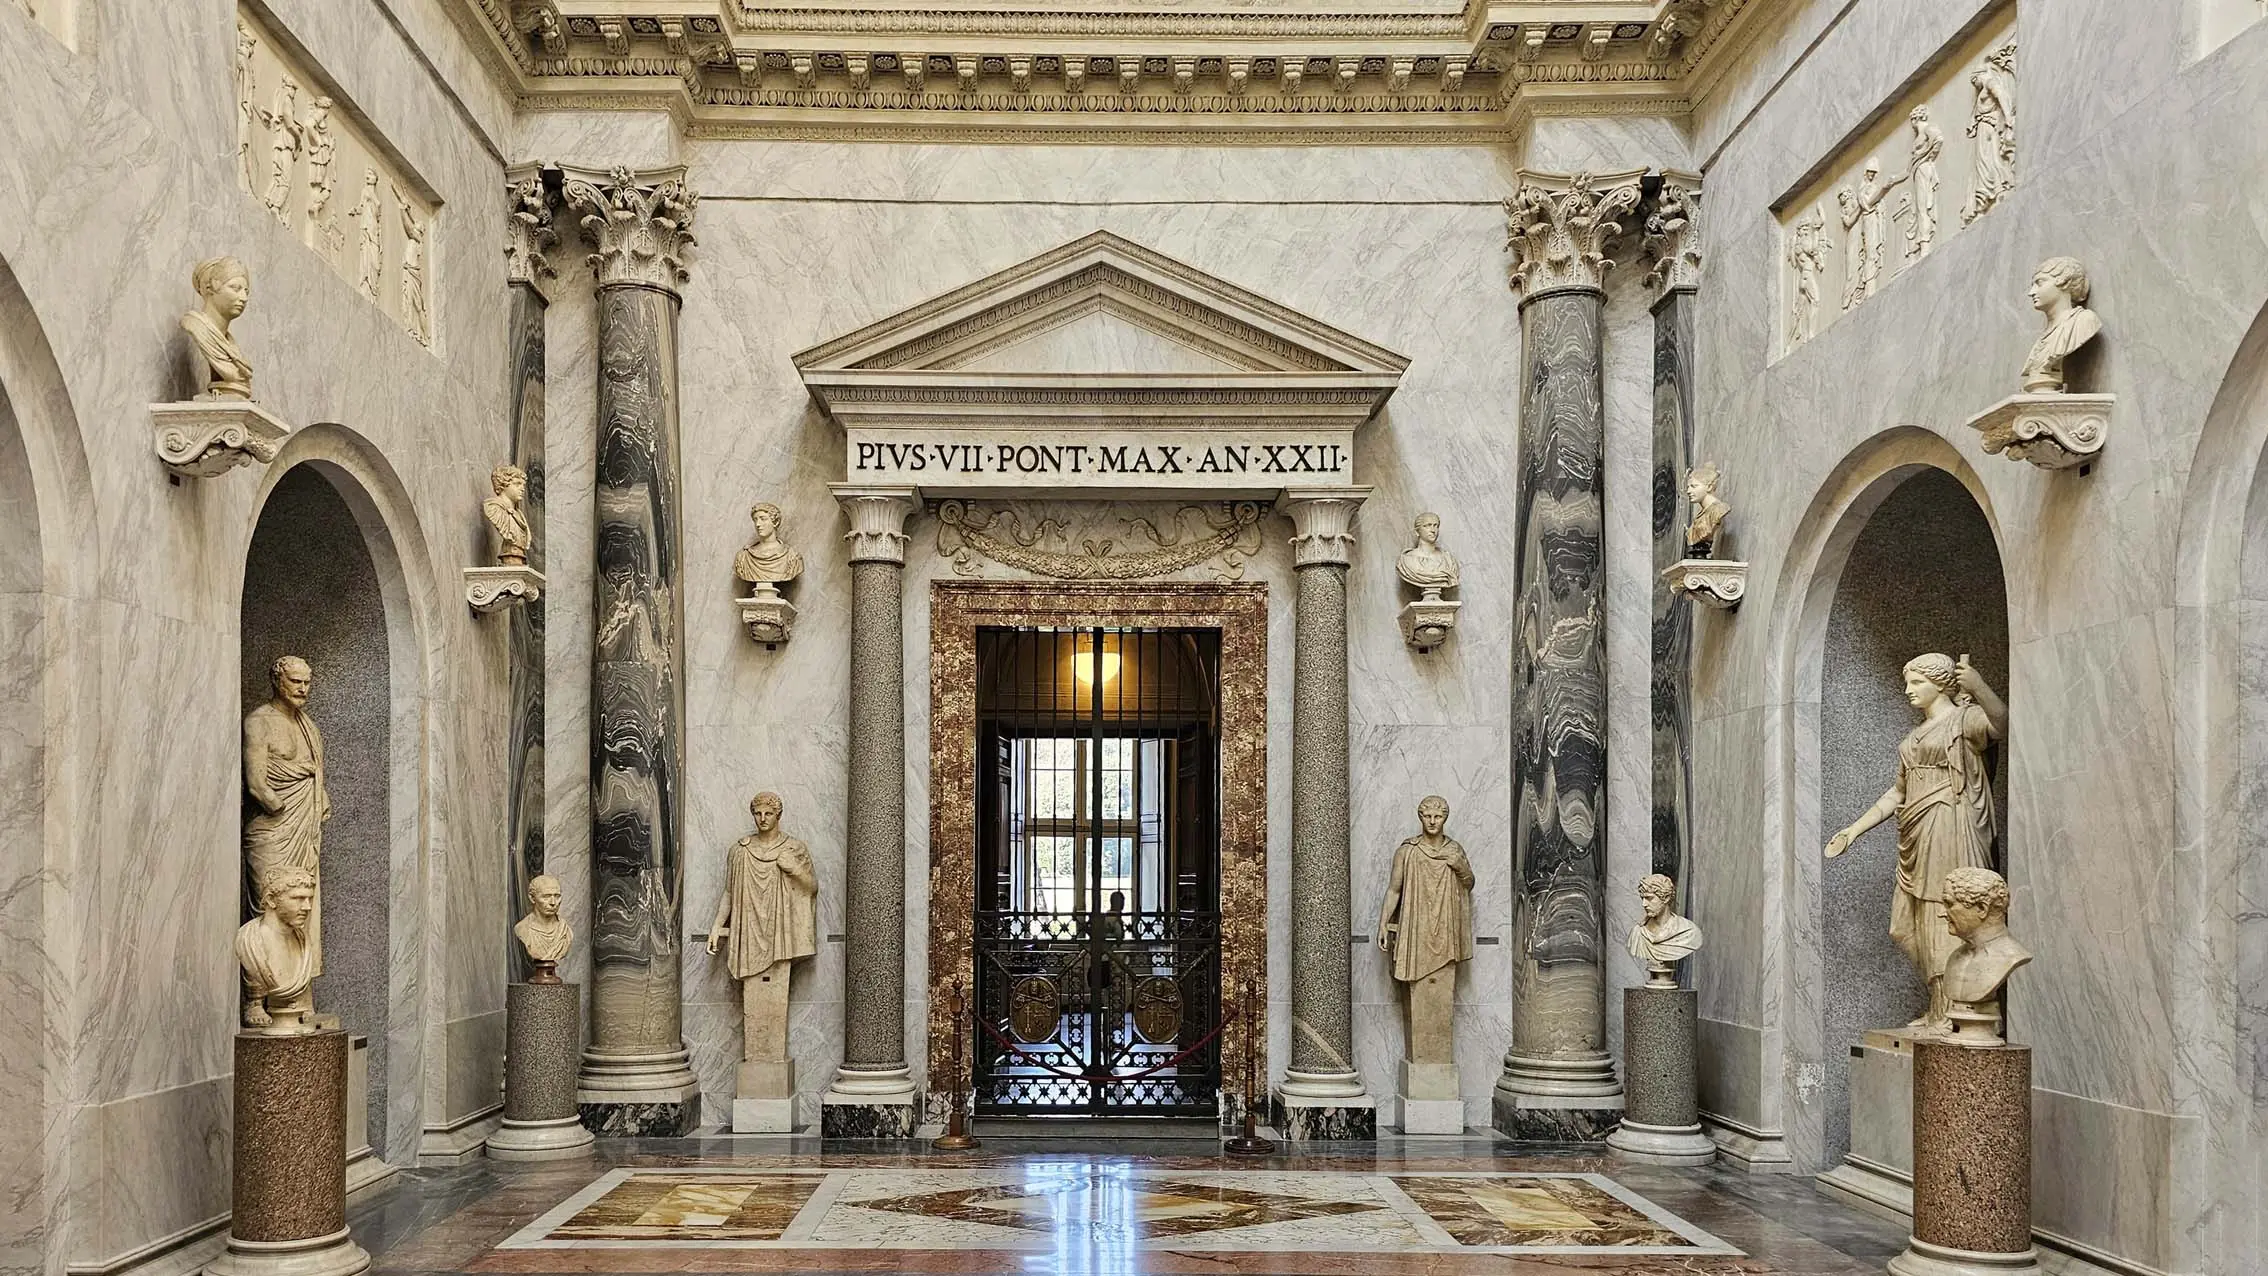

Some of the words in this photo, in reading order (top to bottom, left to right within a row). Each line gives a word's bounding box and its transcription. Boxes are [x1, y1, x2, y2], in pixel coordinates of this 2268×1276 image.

[856, 442, 927, 471] PIVS
[934, 444, 984, 473] VII
[996, 444, 1088, 473] PONT
[1097, 445, 1184, 474] MAX
[1195, 445, 1251, 473] AN
[1261, 444, 1341, 473] XXII
